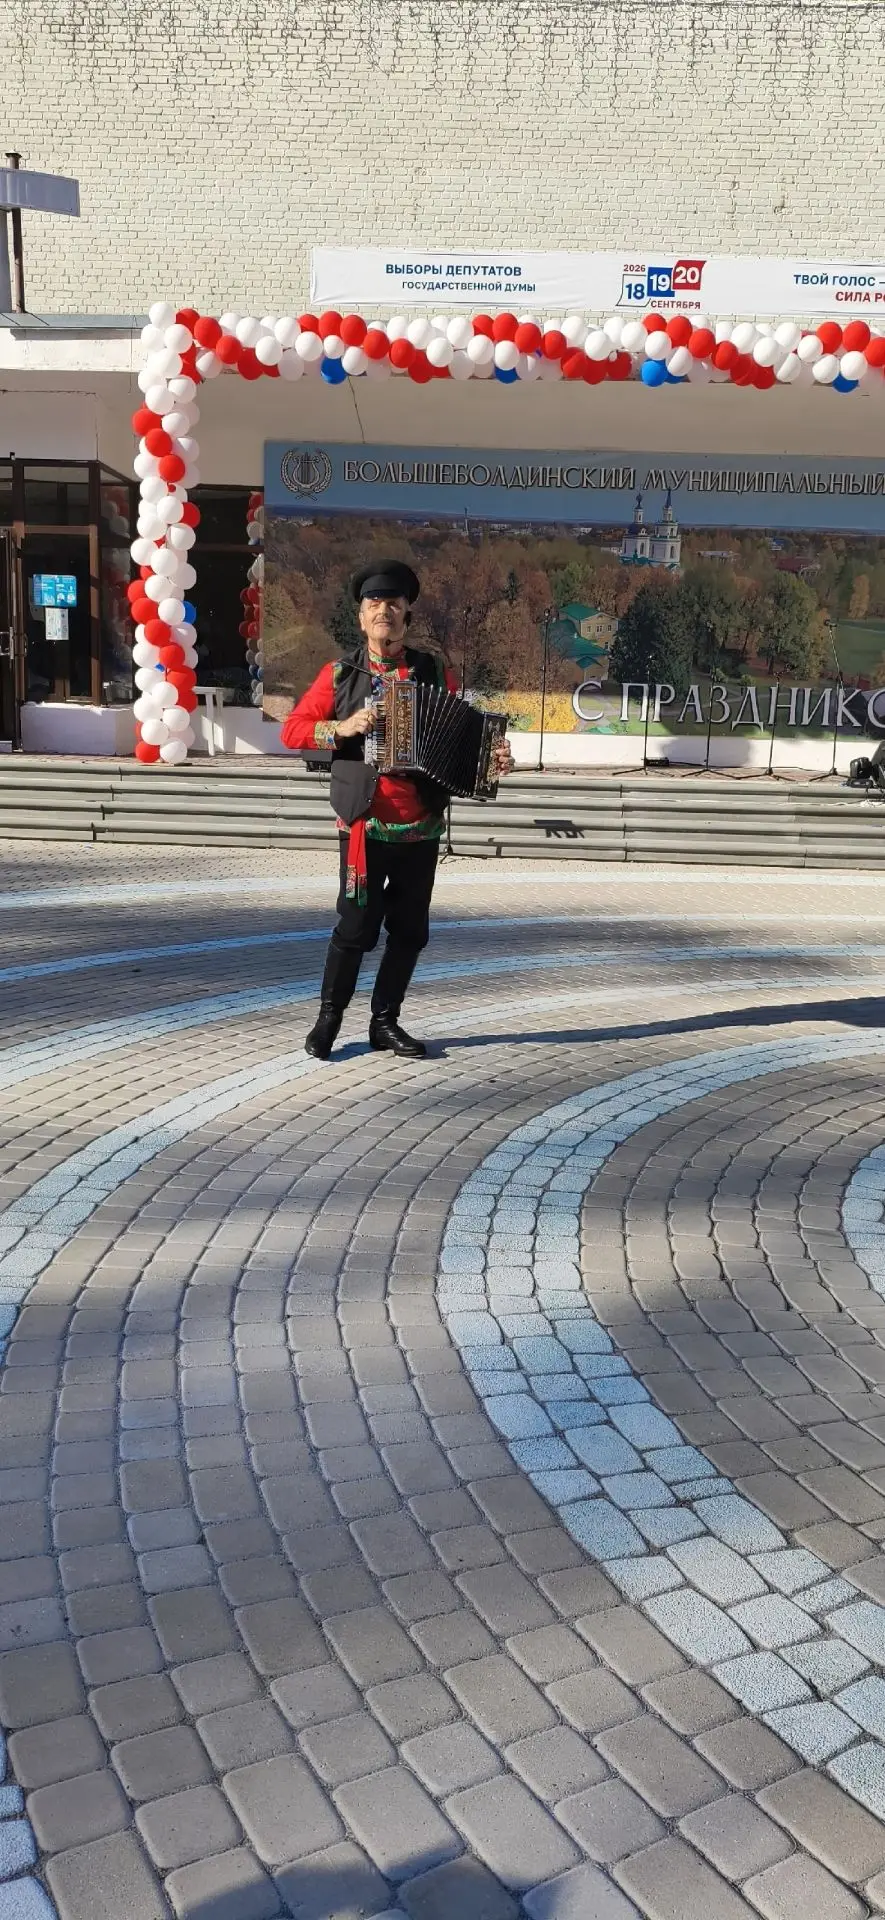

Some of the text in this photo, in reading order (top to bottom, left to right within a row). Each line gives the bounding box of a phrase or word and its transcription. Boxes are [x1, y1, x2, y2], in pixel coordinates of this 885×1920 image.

[385, 263, 522, 277] ВЫБОРЫ ДЕПУТАТОВ
[623, 264, 646, 272] 2026
[402, 280, 536, 292] ГОСУДАРСТВЕННОЙ ДУМЫ
[625, 266, 700, 300] 18 19 20
[793, 273, 829, 286] ТВОЙ
[832, 275, 876, 287] ГОЛОС
[835, 291, 885, 302] СИЛА Р
[650, 300, 701, 309] СЕНТЯБРЯ
[343, 459, 885, 496] БОЛЬШЕБОЛДИНСКИЙ МУНИЦИПАЛЬНЫЙ
[572, 680, 604, 721] С
